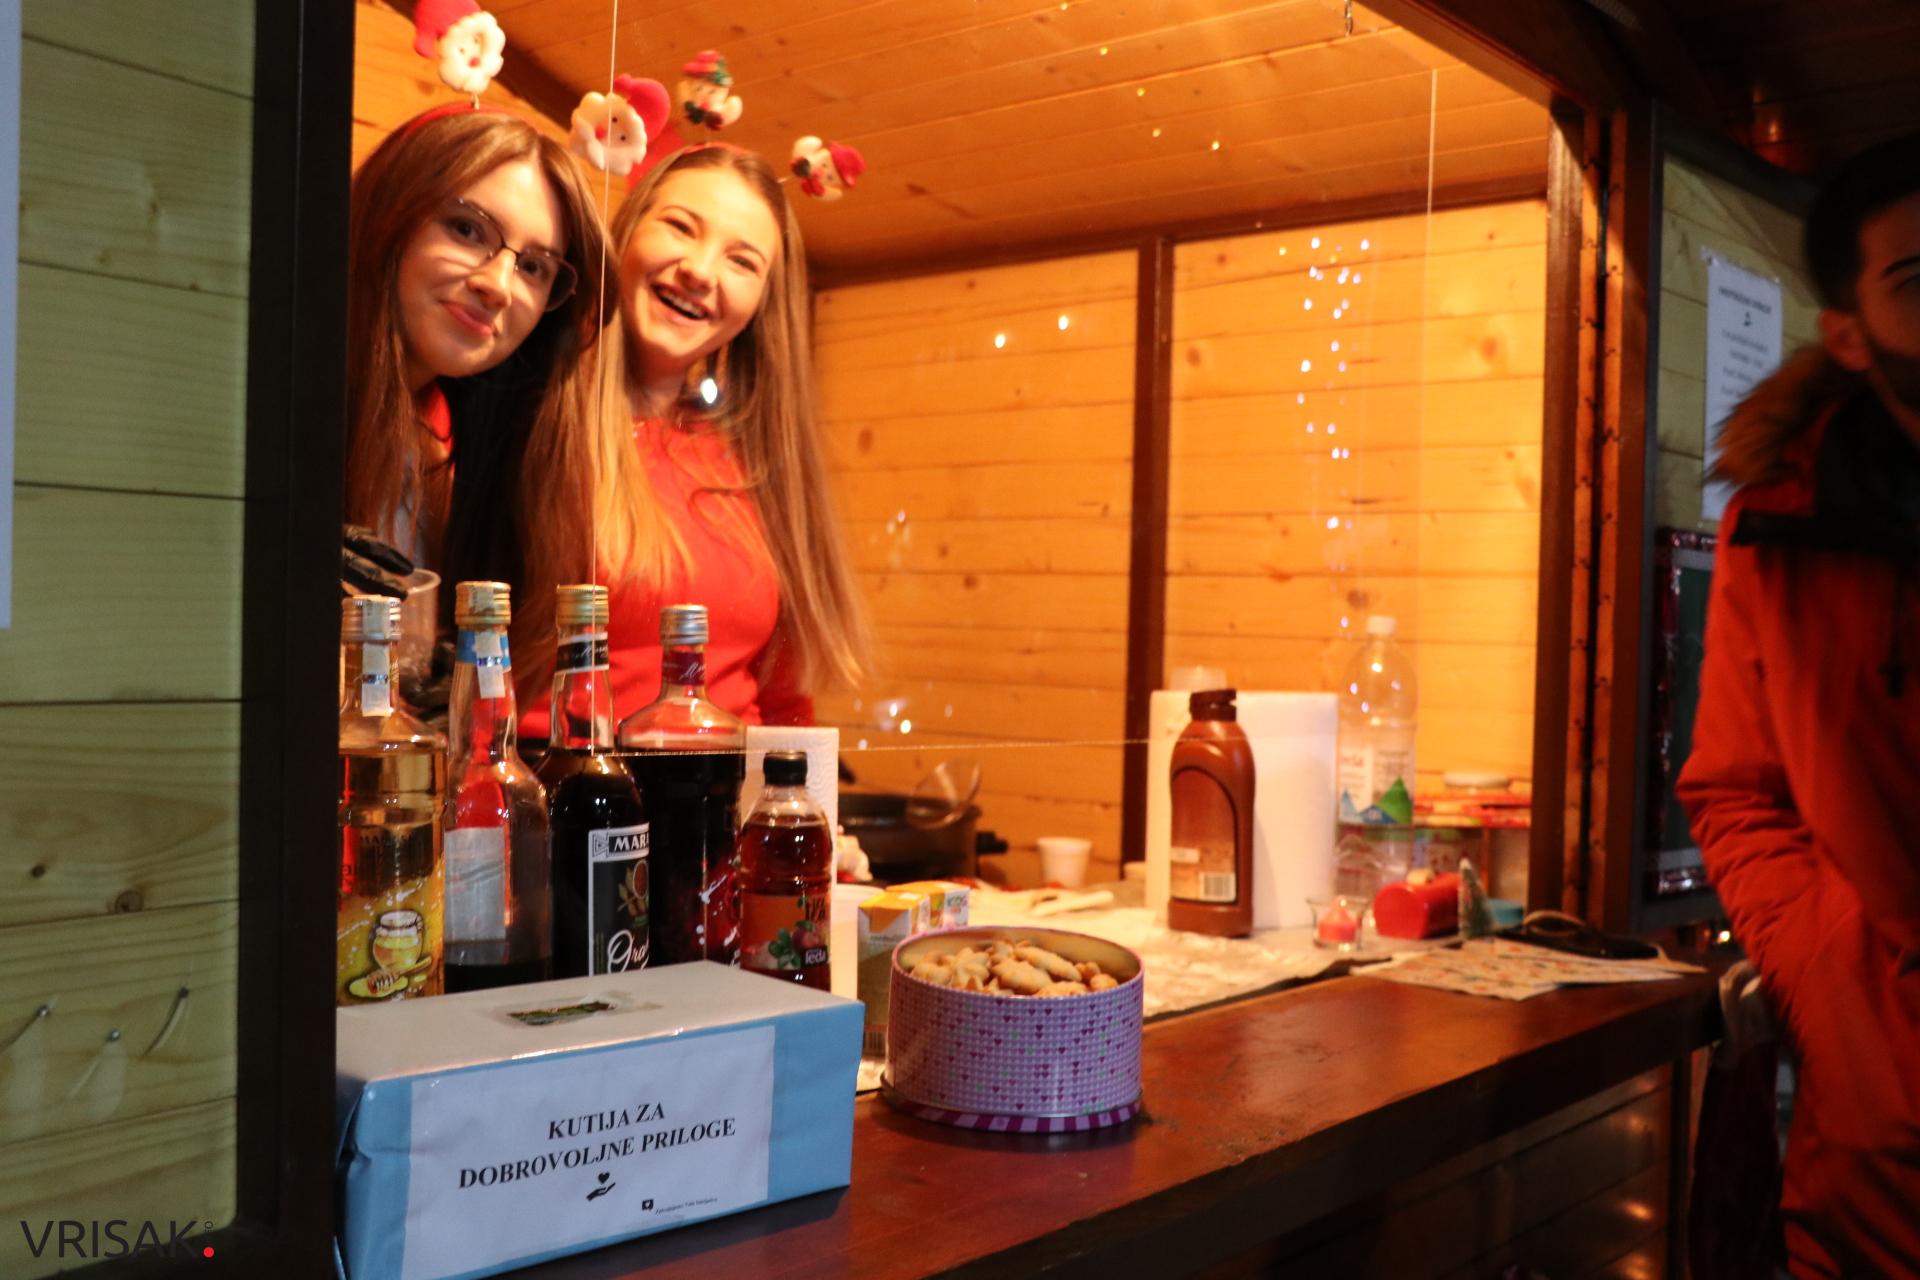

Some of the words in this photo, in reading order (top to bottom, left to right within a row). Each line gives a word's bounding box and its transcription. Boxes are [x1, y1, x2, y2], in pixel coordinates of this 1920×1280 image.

[548, 1109, 630, 1140] KUTIJA
[636, 1102, 665, 1122] ZA
[459, 1137, 635, 1189] DOBROVOLJNE
[641, 1117, 737, 1153] PRILOGE
